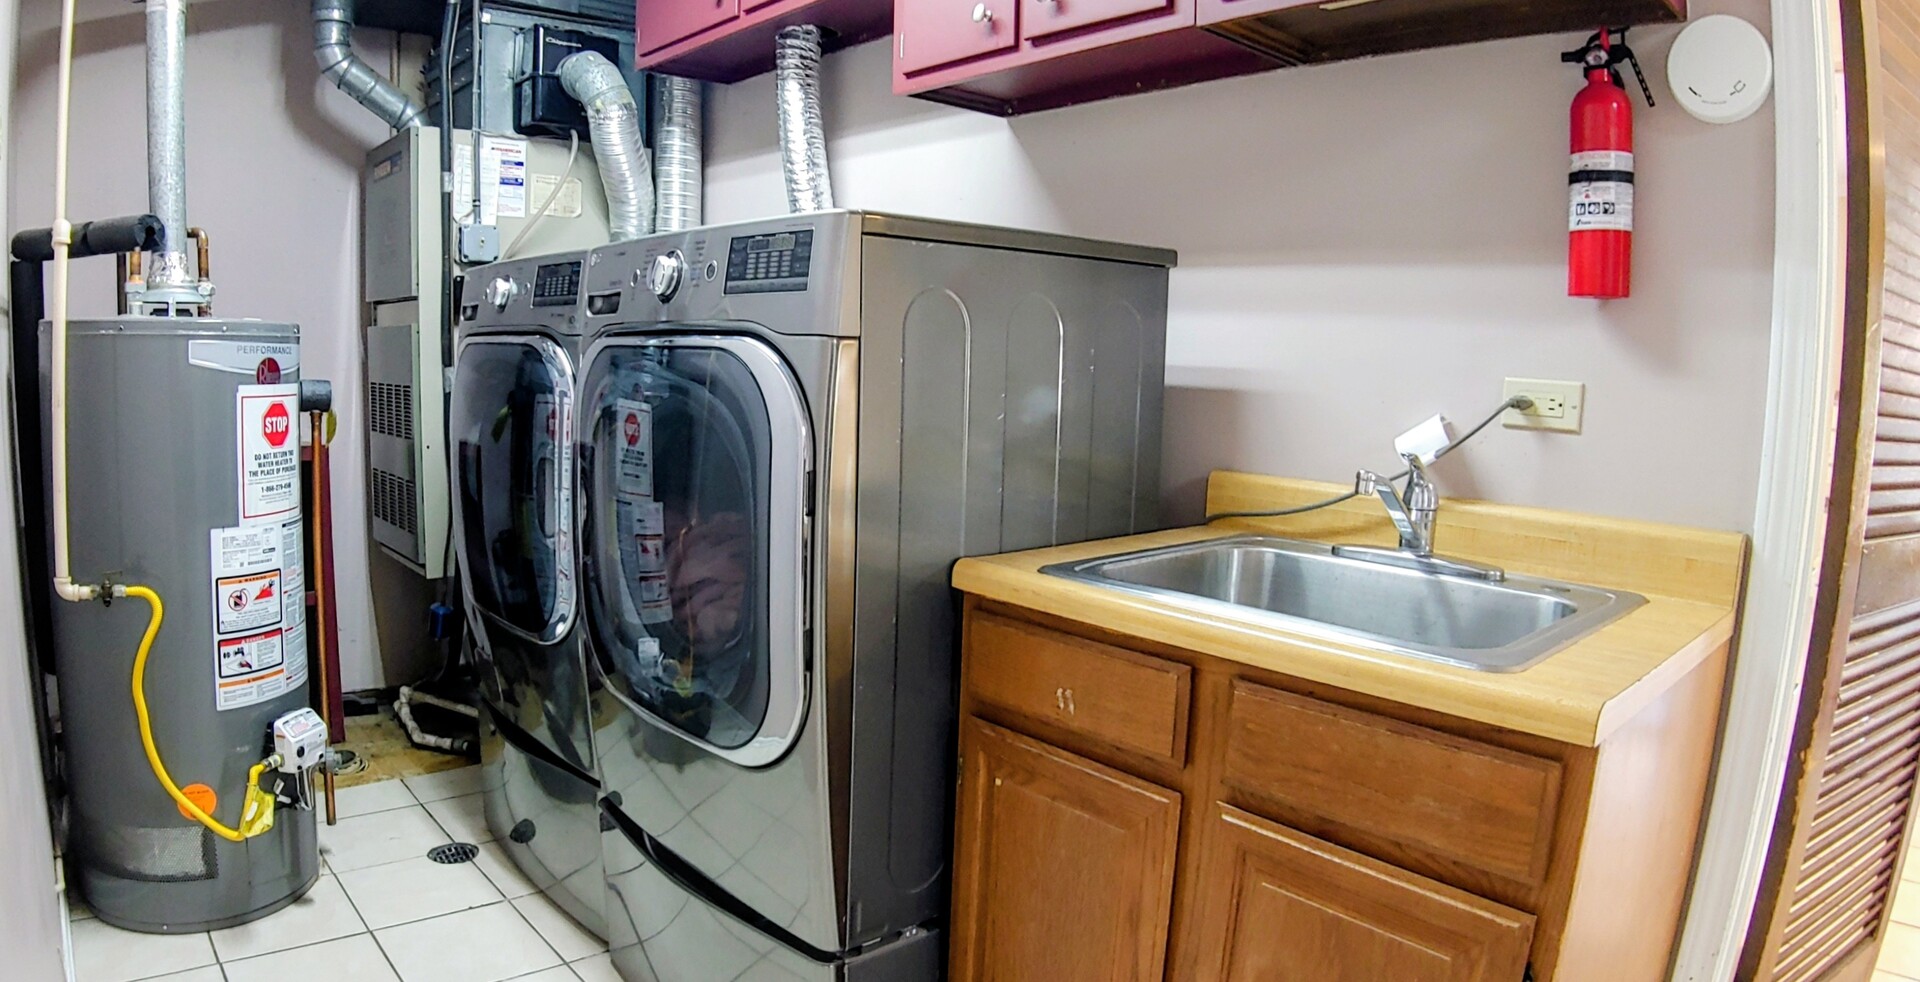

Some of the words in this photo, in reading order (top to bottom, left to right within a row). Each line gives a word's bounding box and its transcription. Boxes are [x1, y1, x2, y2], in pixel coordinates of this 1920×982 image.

[236, 344, 293, 355] PERFORMANCE
[265, 415, 288, 433] STOP
[254, 453, 262, 461] DO
[263, 452, 272, 460] NOT
[257, 460, 274, 469] WATER
[274, 458, 289, 467] HEATER
[248, 470, 259, 478] THE
[260, 468, 275, 477] PLACE
[275, 466, 281, 475] OF
